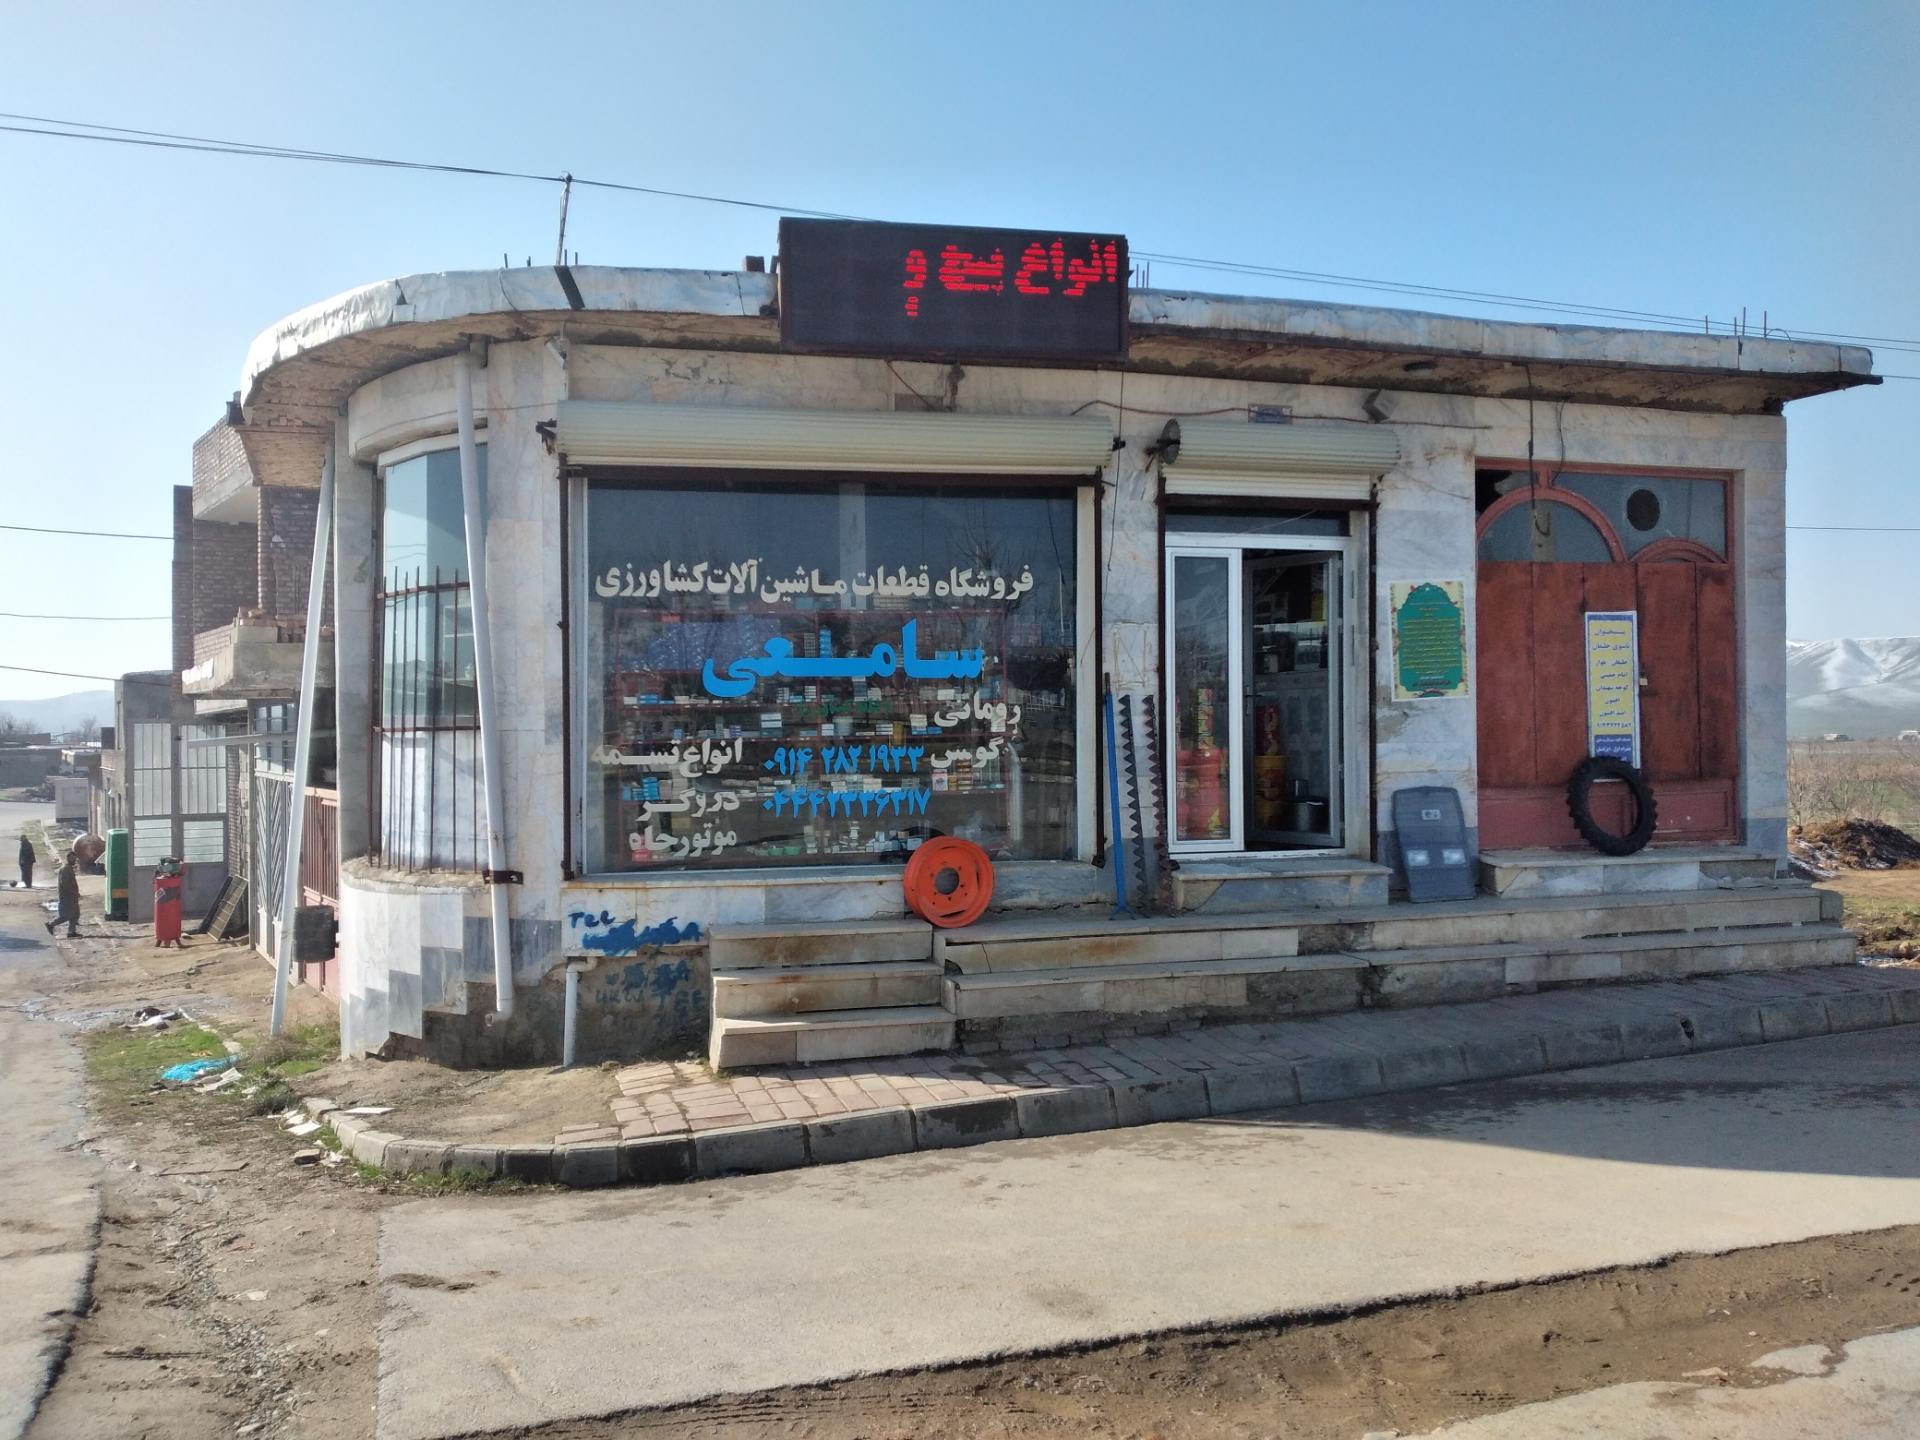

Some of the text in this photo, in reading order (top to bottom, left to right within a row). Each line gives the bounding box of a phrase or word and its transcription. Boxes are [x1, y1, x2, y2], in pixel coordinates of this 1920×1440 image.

[1015, 238, 1118, 296] انواع
[595, 558, 1034, 603] فروشگاه قطعات ماشین آلات کشاورزی
[703, 618, 984, 698] سامعی
[590, 737, 743, 778] انواع تسمه
[635, 788, 741, 822] دروگر
